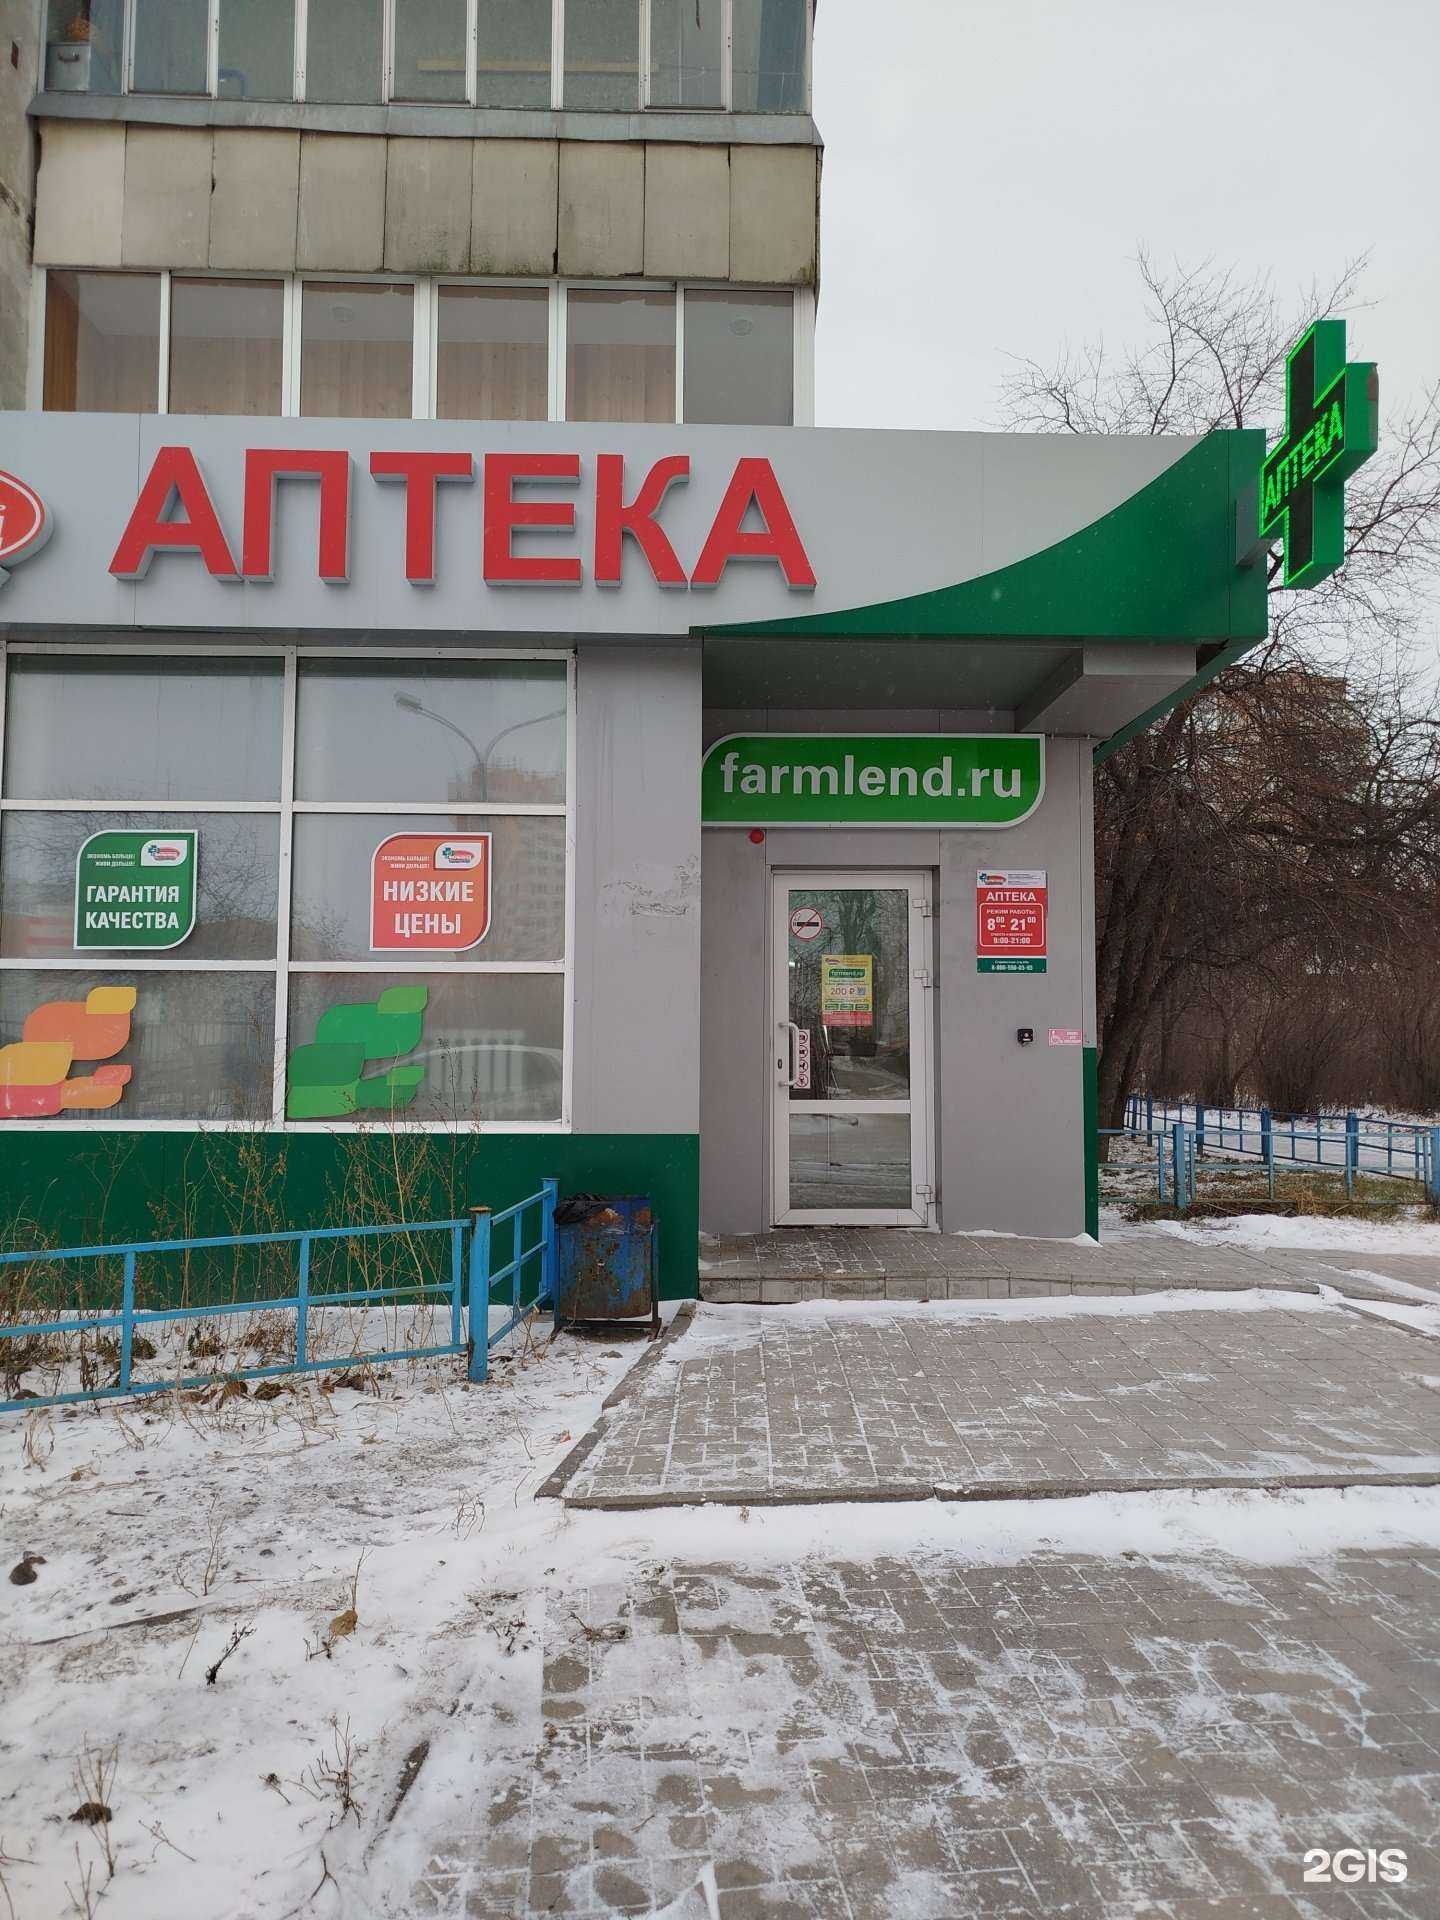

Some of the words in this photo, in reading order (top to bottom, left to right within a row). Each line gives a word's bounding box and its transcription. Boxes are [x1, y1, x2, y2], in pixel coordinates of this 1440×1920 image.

[1263, 400, 1344, 520] АПТЕКА
[108, 446, 817, 591] АПТЕКА
[720, 752, 1021, 798] farmlend.ru
[86, 885, 180, 903] ГАРАНТИЯ
[383, 880, 474, 902] НИЗКИЕ
[986, 891, 1037, 902] АПТЕКА
[85, 911, 180, 929] КАЧЕСТВА
[395, 913, 461, 938] ЦЕНЫ
